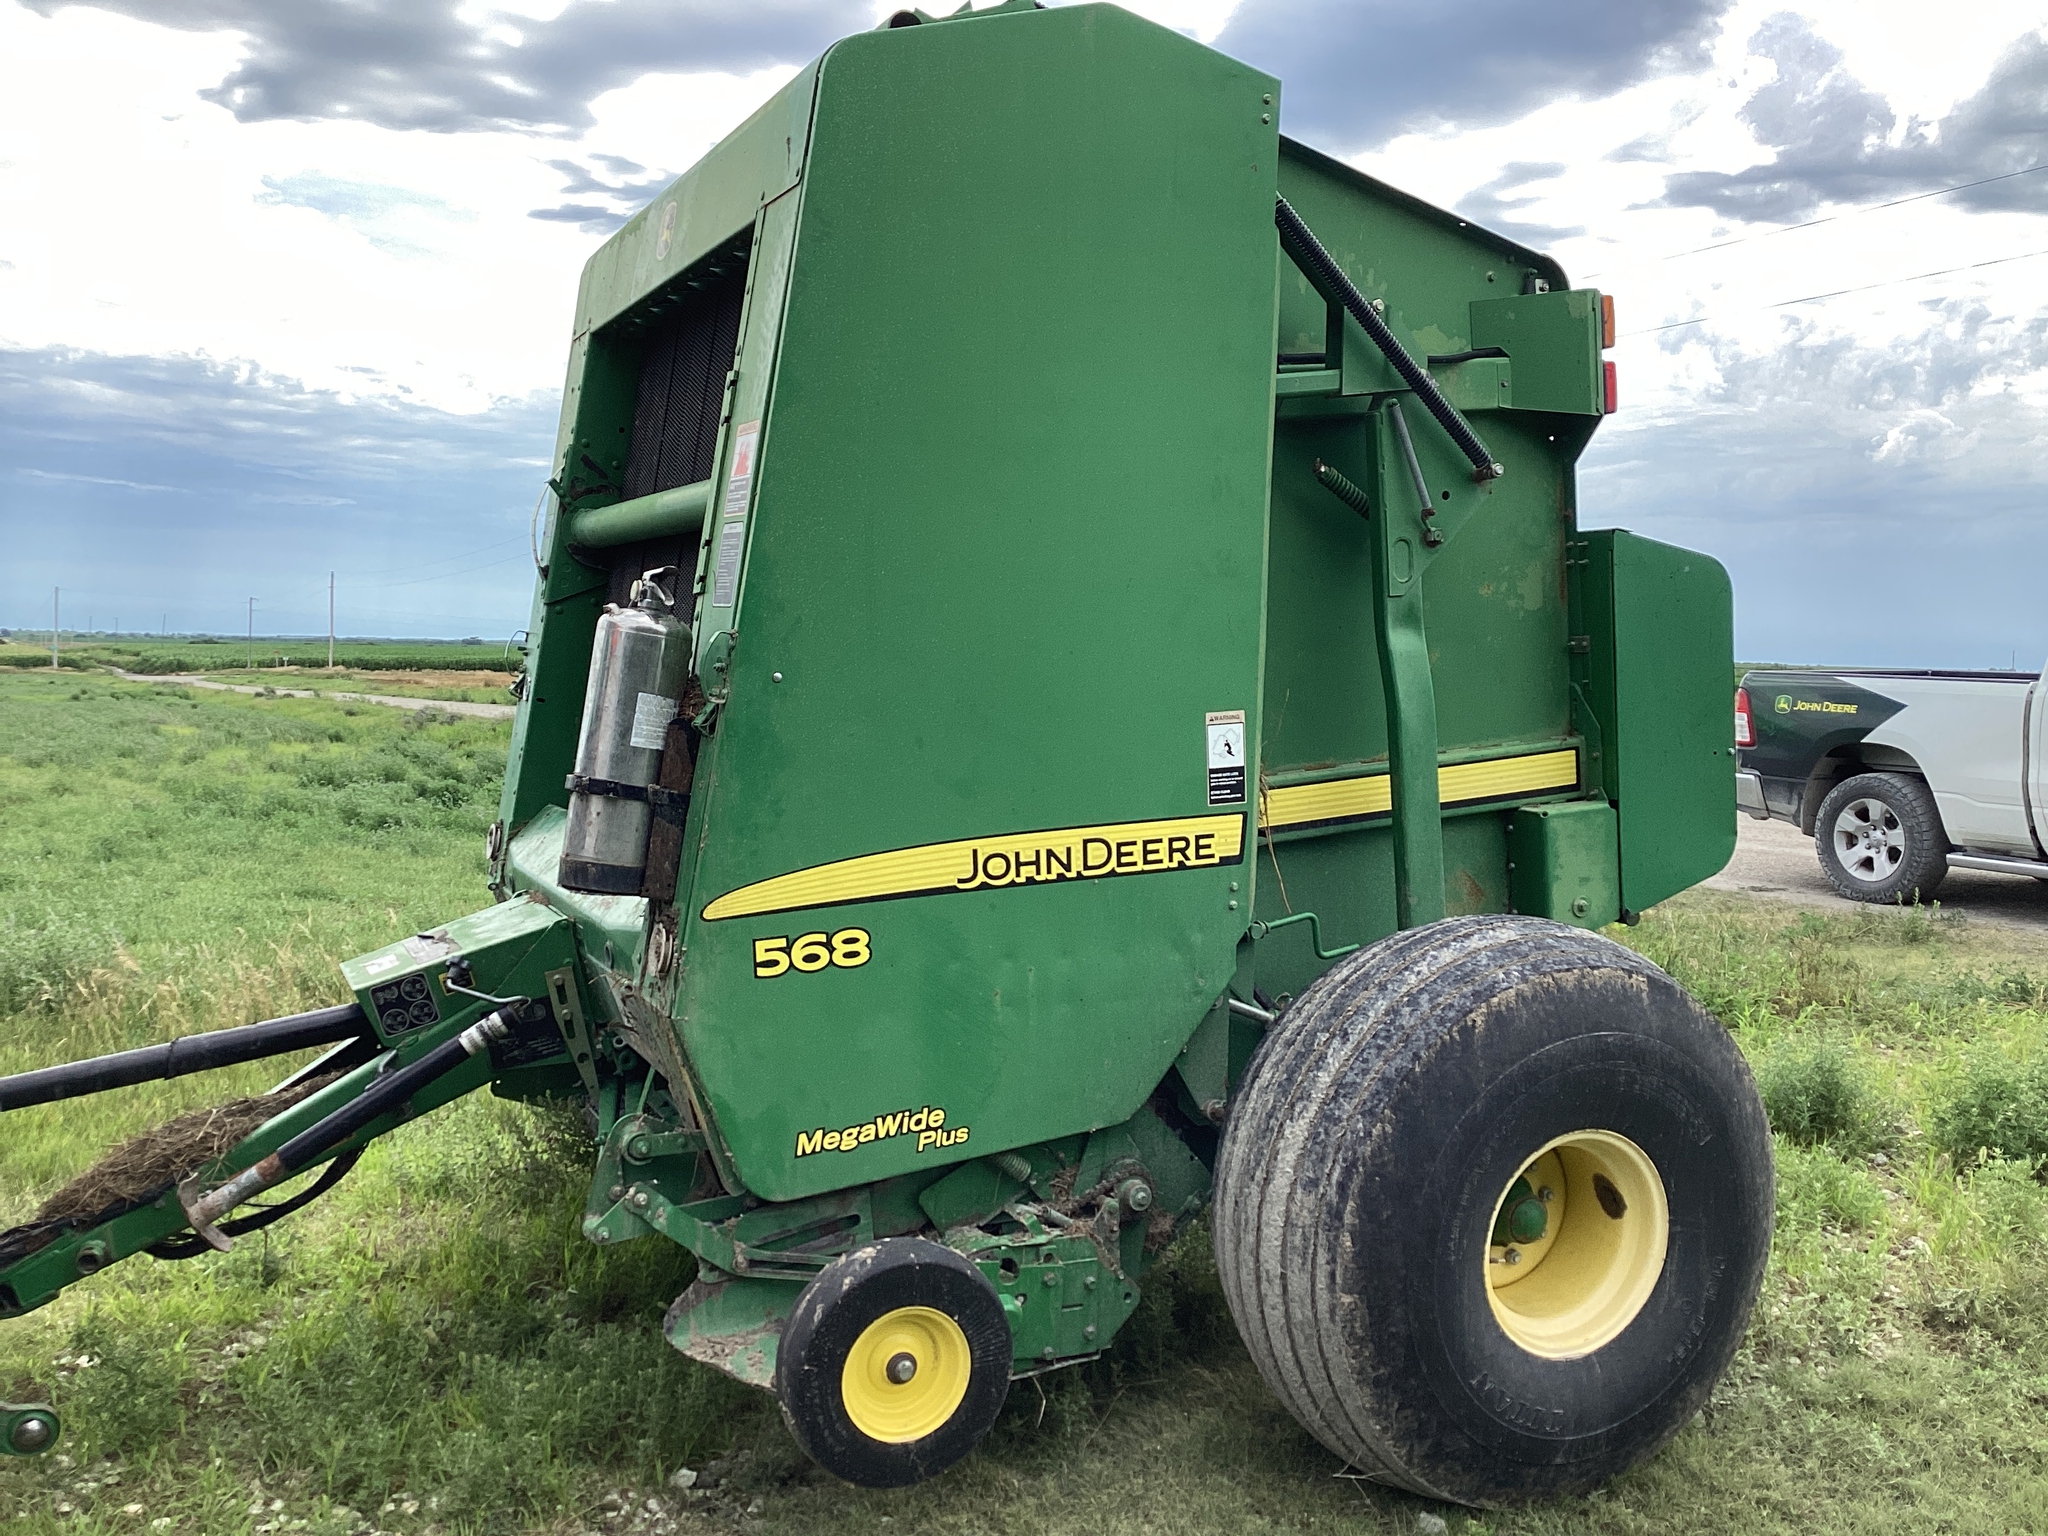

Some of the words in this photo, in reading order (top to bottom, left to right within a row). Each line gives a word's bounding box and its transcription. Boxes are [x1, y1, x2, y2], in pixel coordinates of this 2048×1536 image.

[1794, 701, 1822, 712] JOHN
[1823, 702, 1858, 714] DEERE
[957, 847, 1076, 889] JOHN
[1082, 833, 1217, 879] DEERE
[753, 928, 872, 978] 568
[795, 1106, 946, 1158] MegaWide
[916, 1125, 970, 1154] Plus
